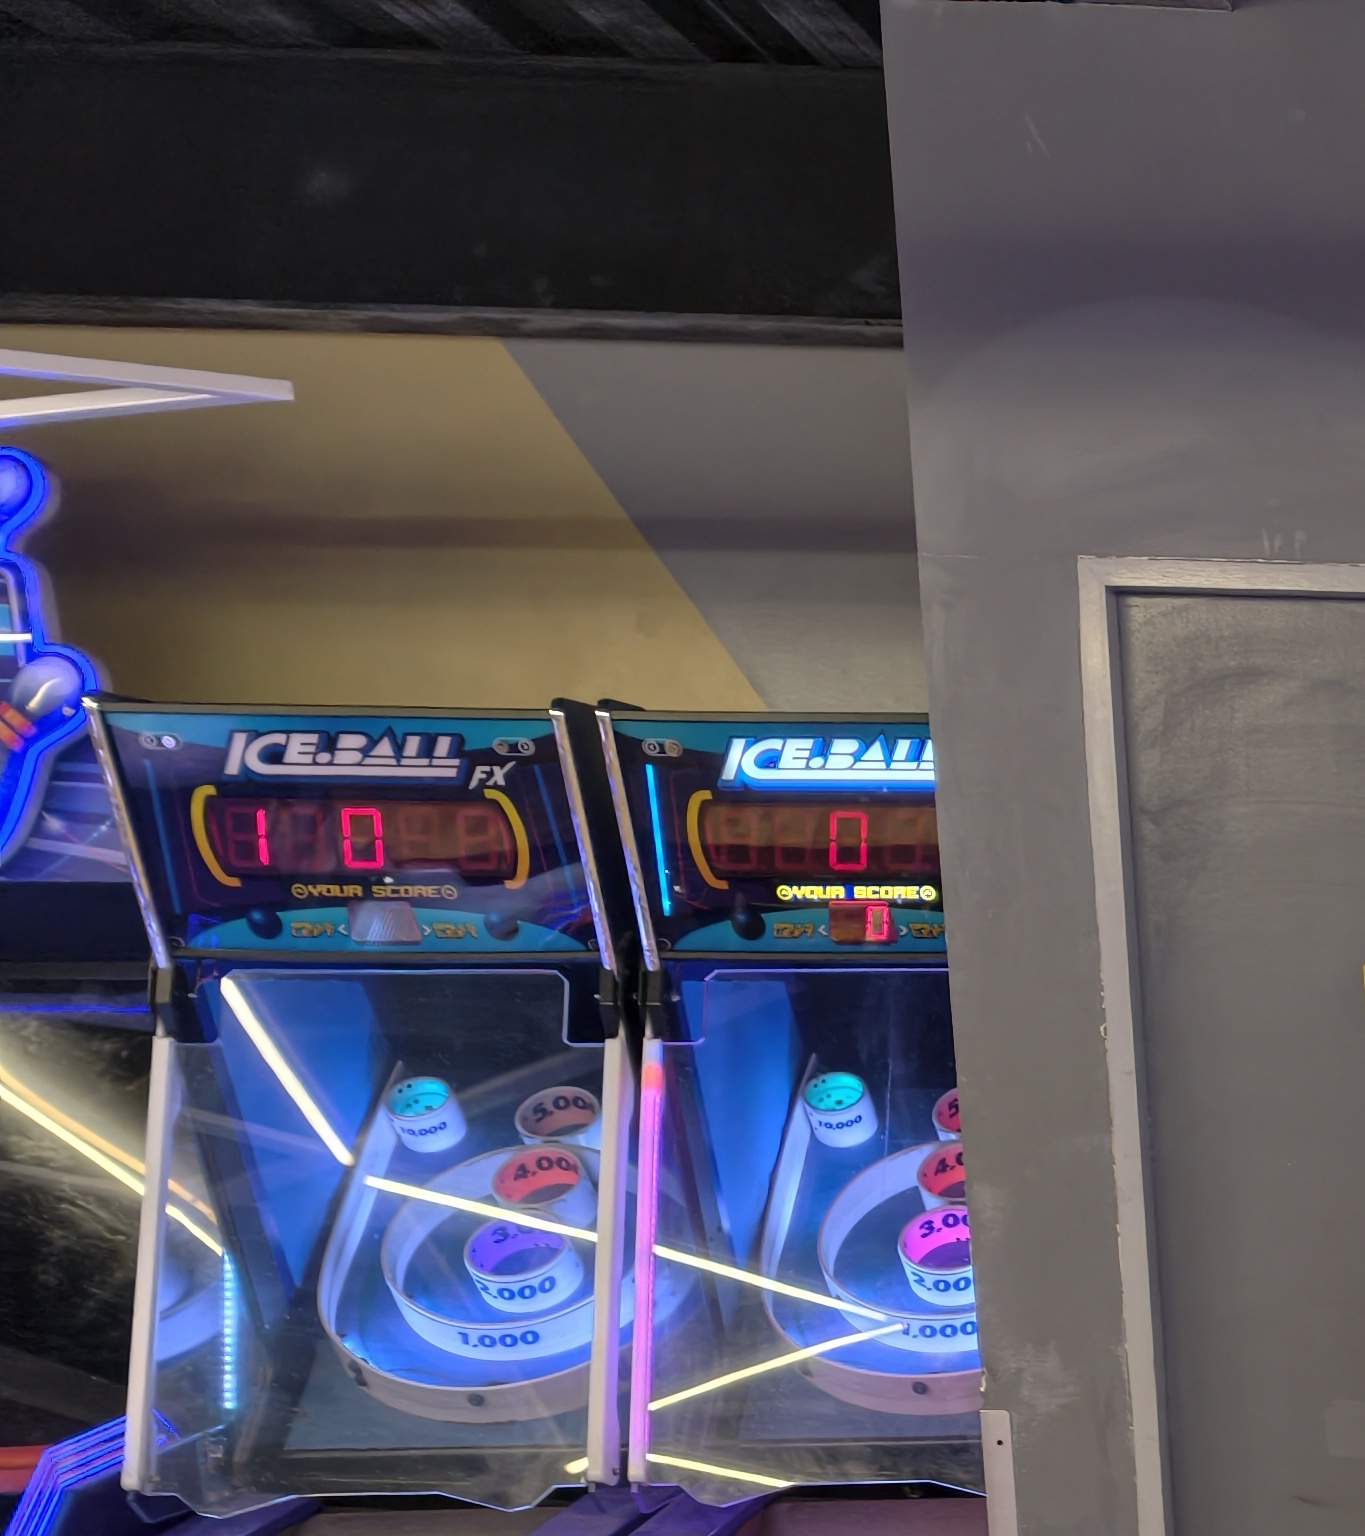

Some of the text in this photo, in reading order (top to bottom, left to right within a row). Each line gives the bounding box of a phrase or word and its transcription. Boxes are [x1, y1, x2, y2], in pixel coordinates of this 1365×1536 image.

[468, 760, 517, 790] FX
[307, 885, 441, 899] YOUR SCORE
[790, 885, 920, 900] YOUR SCORE
